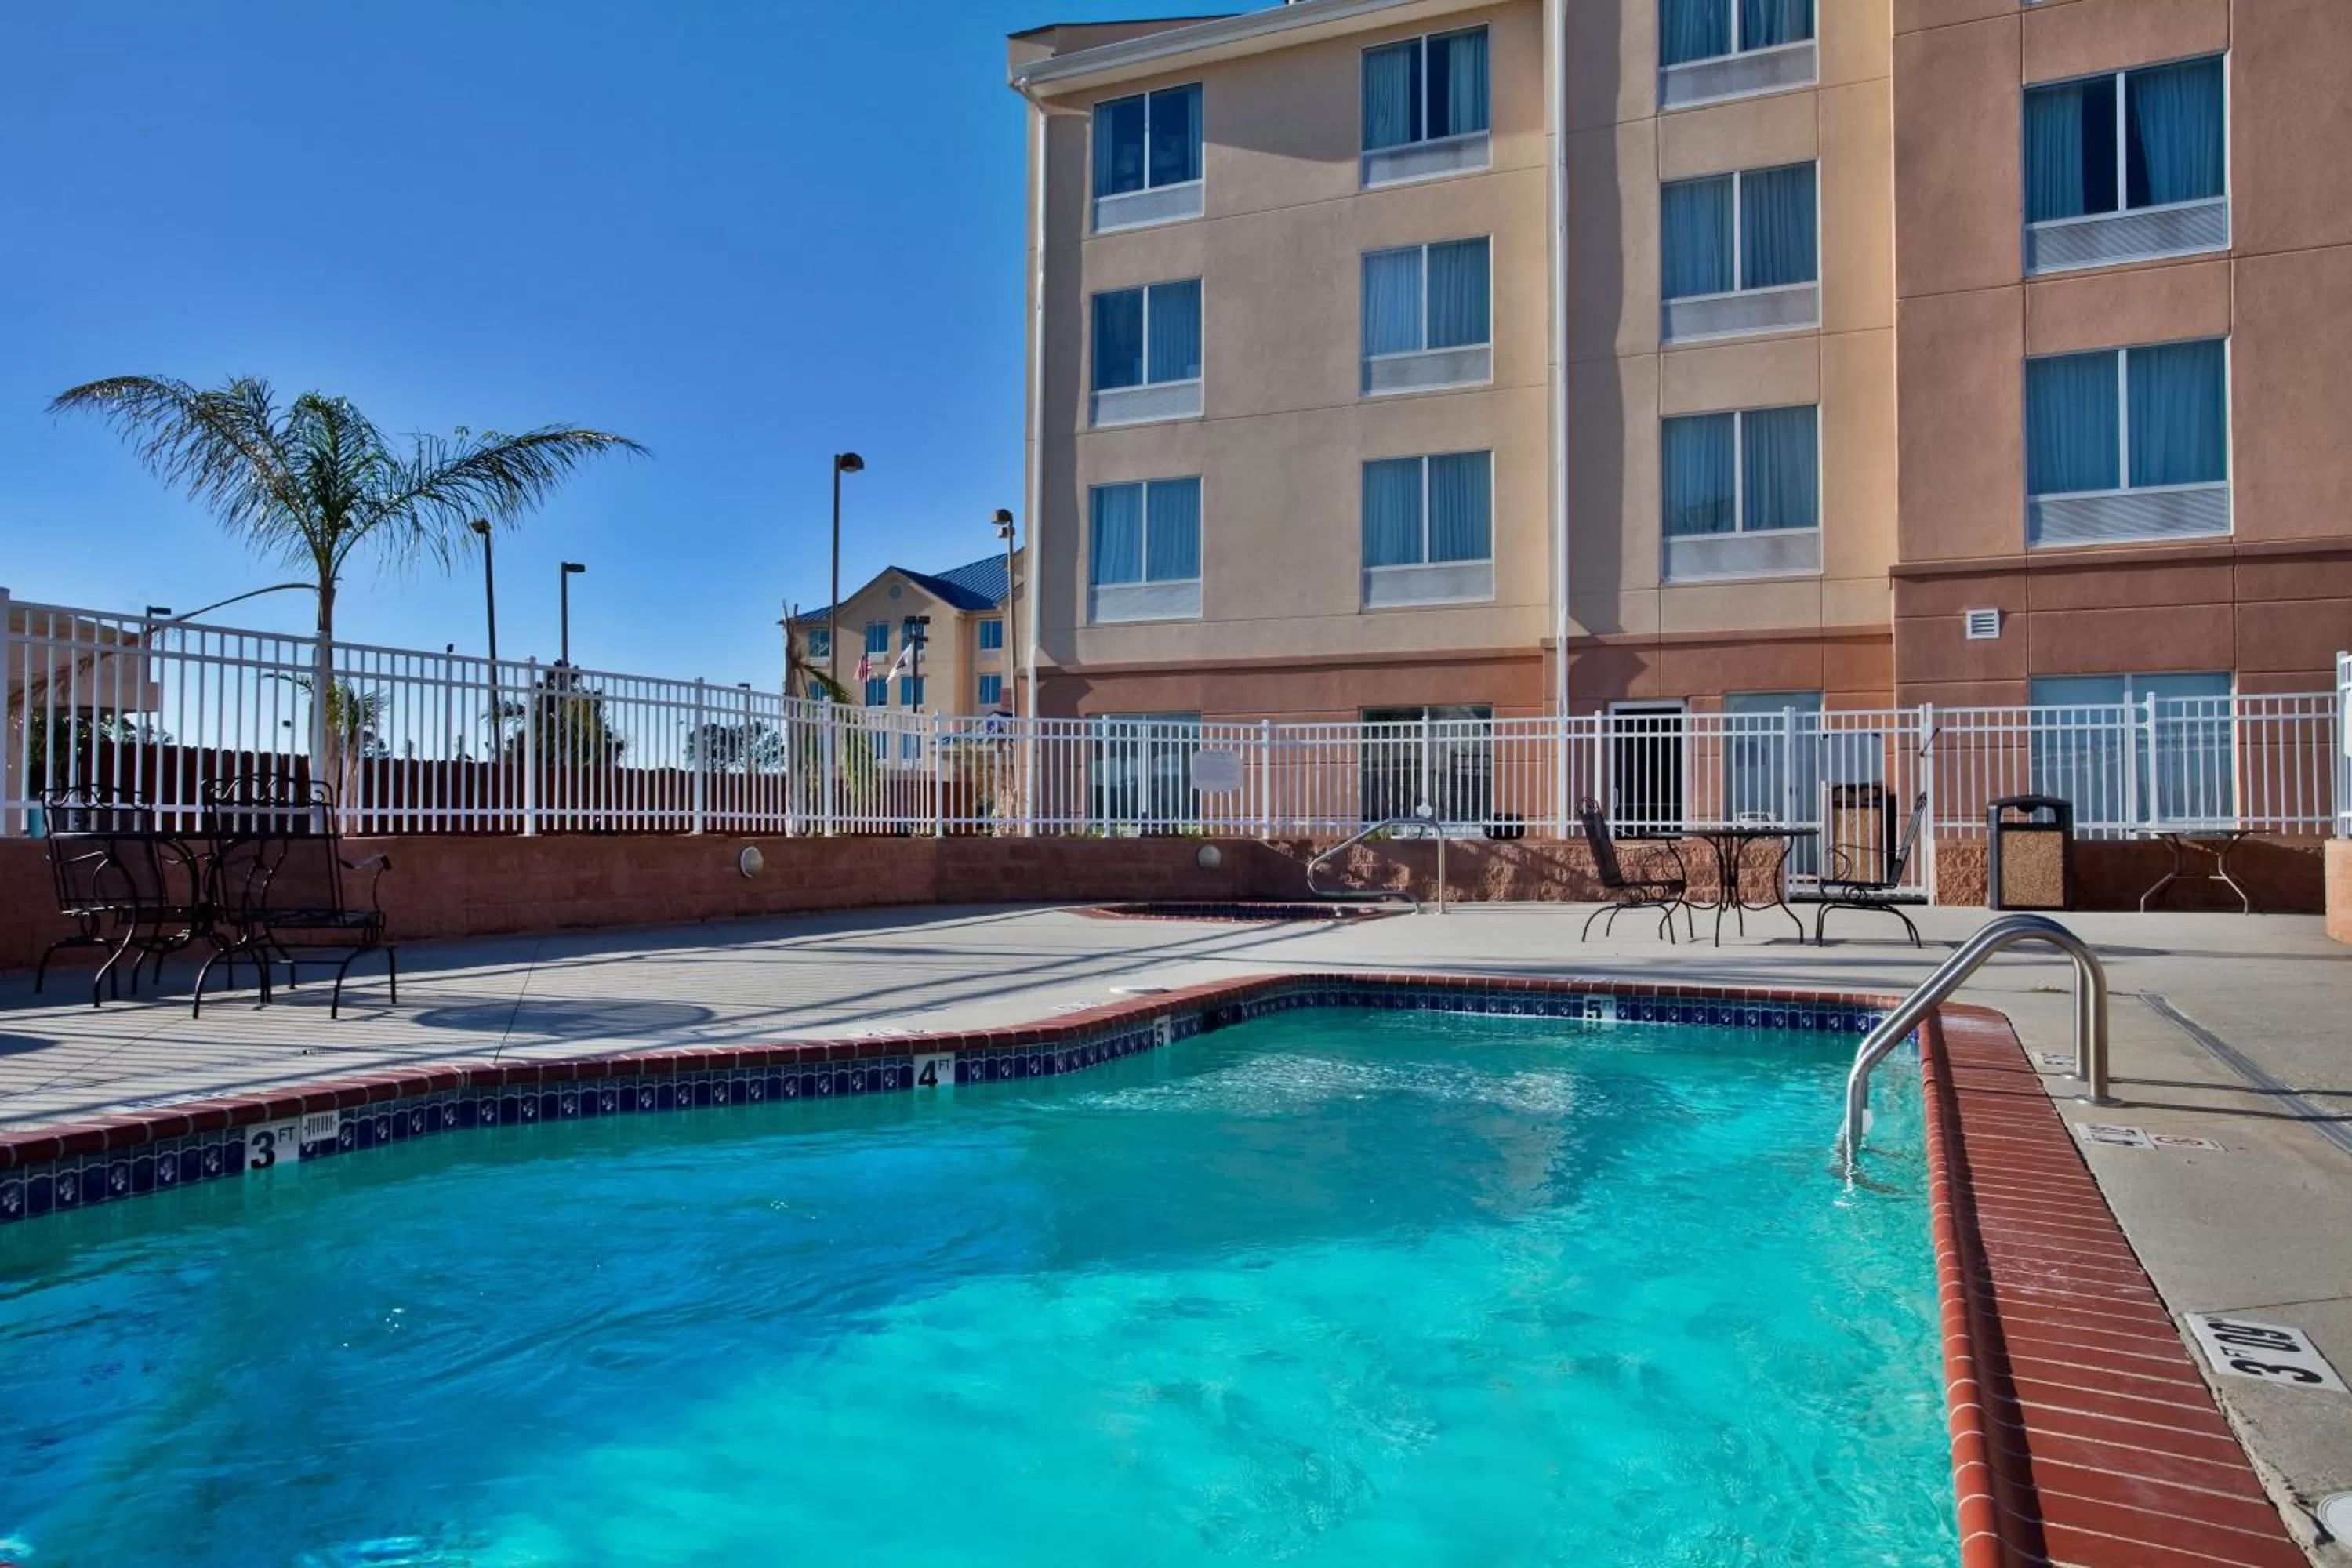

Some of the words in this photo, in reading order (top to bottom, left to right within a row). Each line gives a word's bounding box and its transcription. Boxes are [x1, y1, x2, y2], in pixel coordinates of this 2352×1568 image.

[1587, 1000, 1602, 1019] 5
[918, 1059, 938, 1086] 4
[251, 1131, 275, 1170] 3
[278, 1127, 295, 1142] FT
[2230, 1359, 2323, 1384] 3
